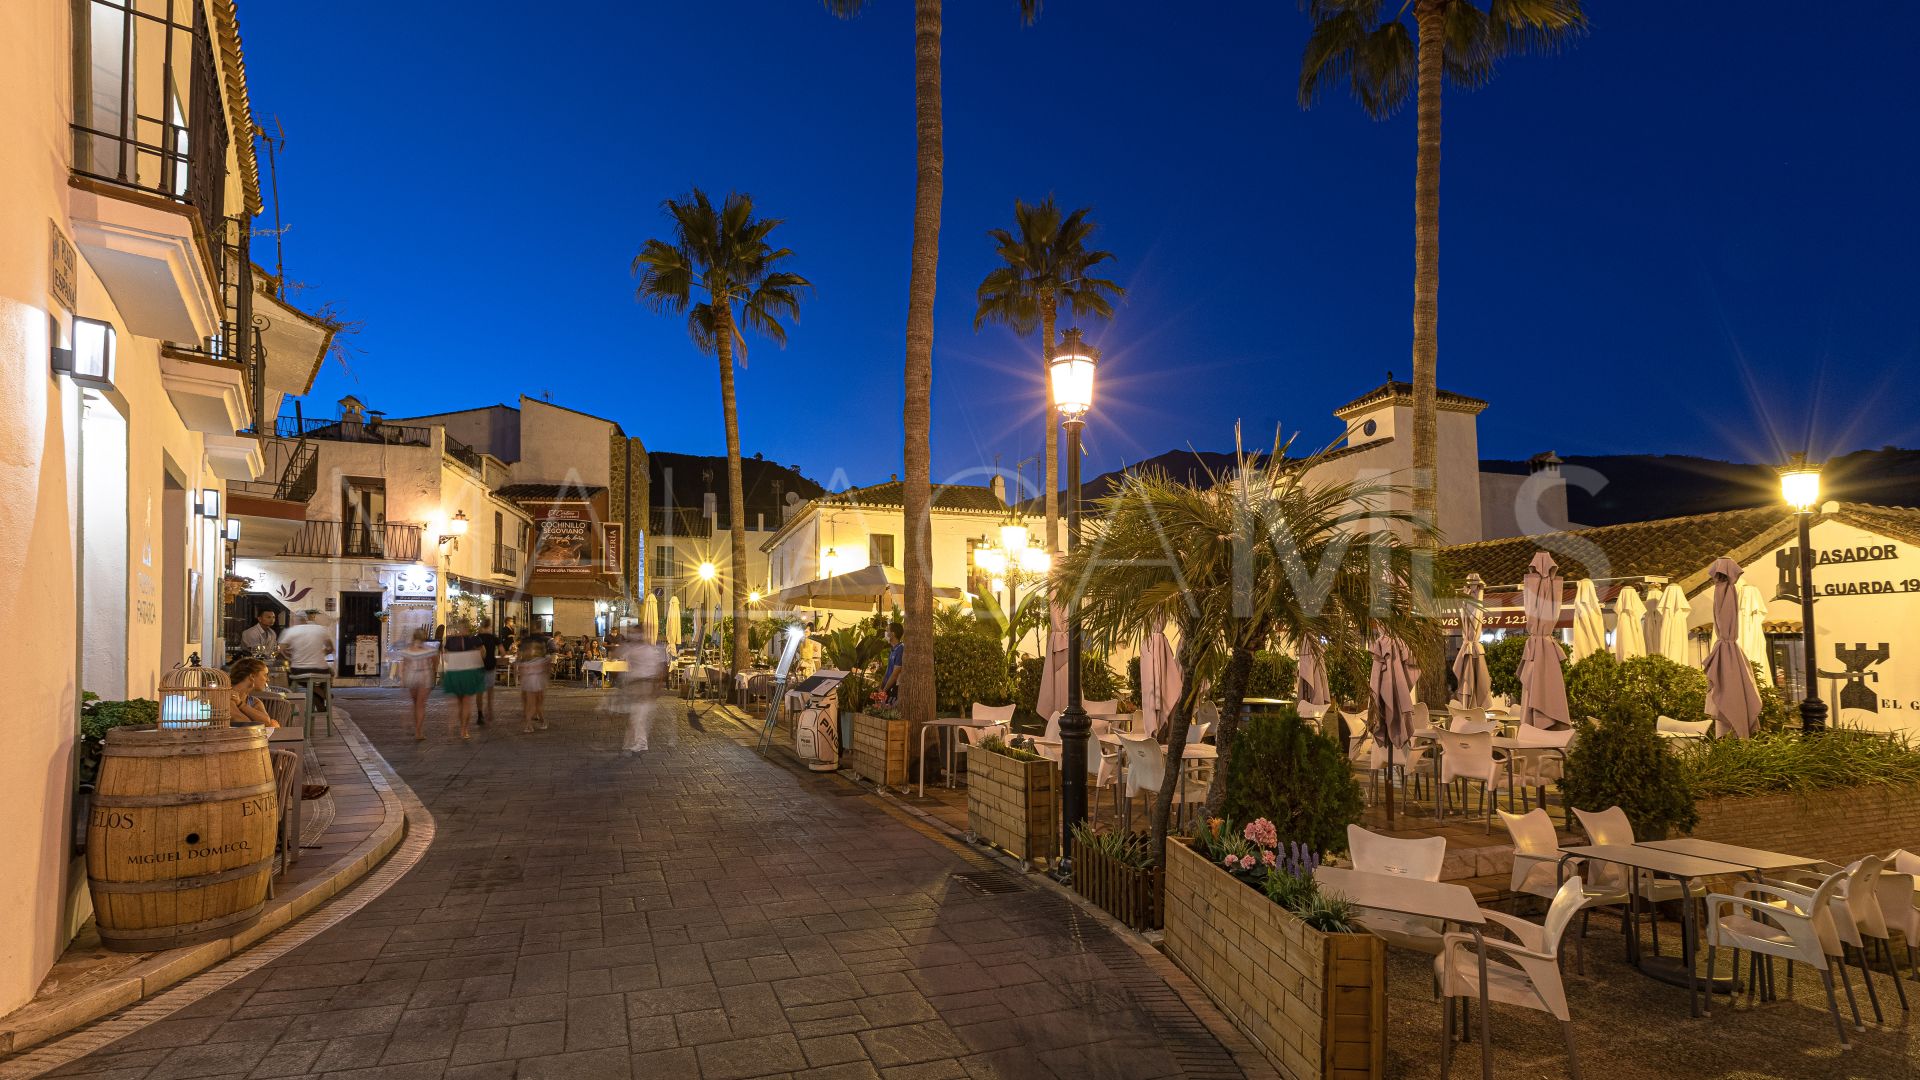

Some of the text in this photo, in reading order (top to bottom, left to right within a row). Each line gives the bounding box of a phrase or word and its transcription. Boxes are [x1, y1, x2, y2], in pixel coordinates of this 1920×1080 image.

[541, 521, 586, 529] COCHINILLO
[609, 529, 617, 568] PIZZERÍA
[1819, 544, 1899, 564] ASADOR
[1824, 580, 1896, 595] GUARDA
[1881, 698, 1902, 710] EL
[820, 718, 839, 749] PING
[127, 840, 252, 865] MIGUEL DOMECQ
